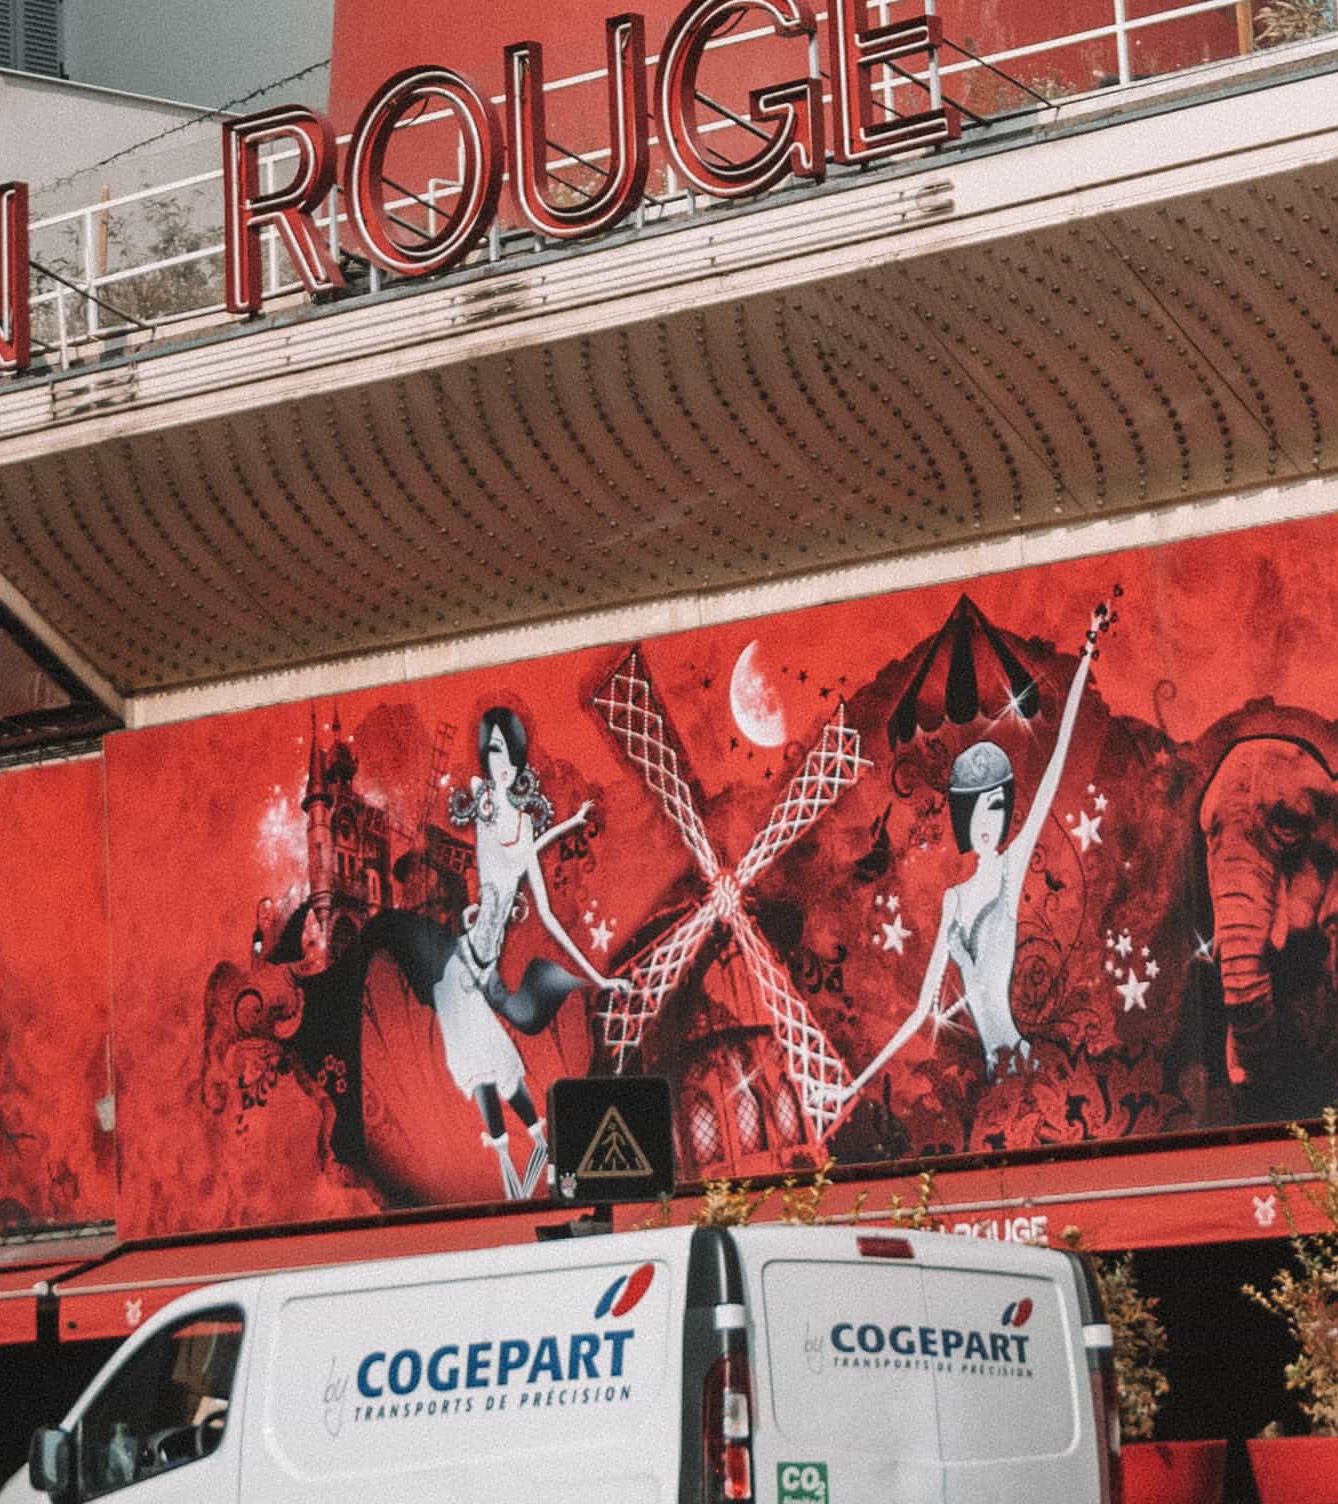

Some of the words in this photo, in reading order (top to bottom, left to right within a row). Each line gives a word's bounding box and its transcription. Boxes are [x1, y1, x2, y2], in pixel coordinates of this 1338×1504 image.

[830, 1323, 1029, 1364] COGEPART
[356, 1328, 635, 1398] COGEPART
[833, 1356, 930, 1372] TRANSPORTS
[936, 1363, 952, 1373] DE
[354, 1396, 473, 1423] TRANSPORTS
[485, 1391, 507, 1411] DE
